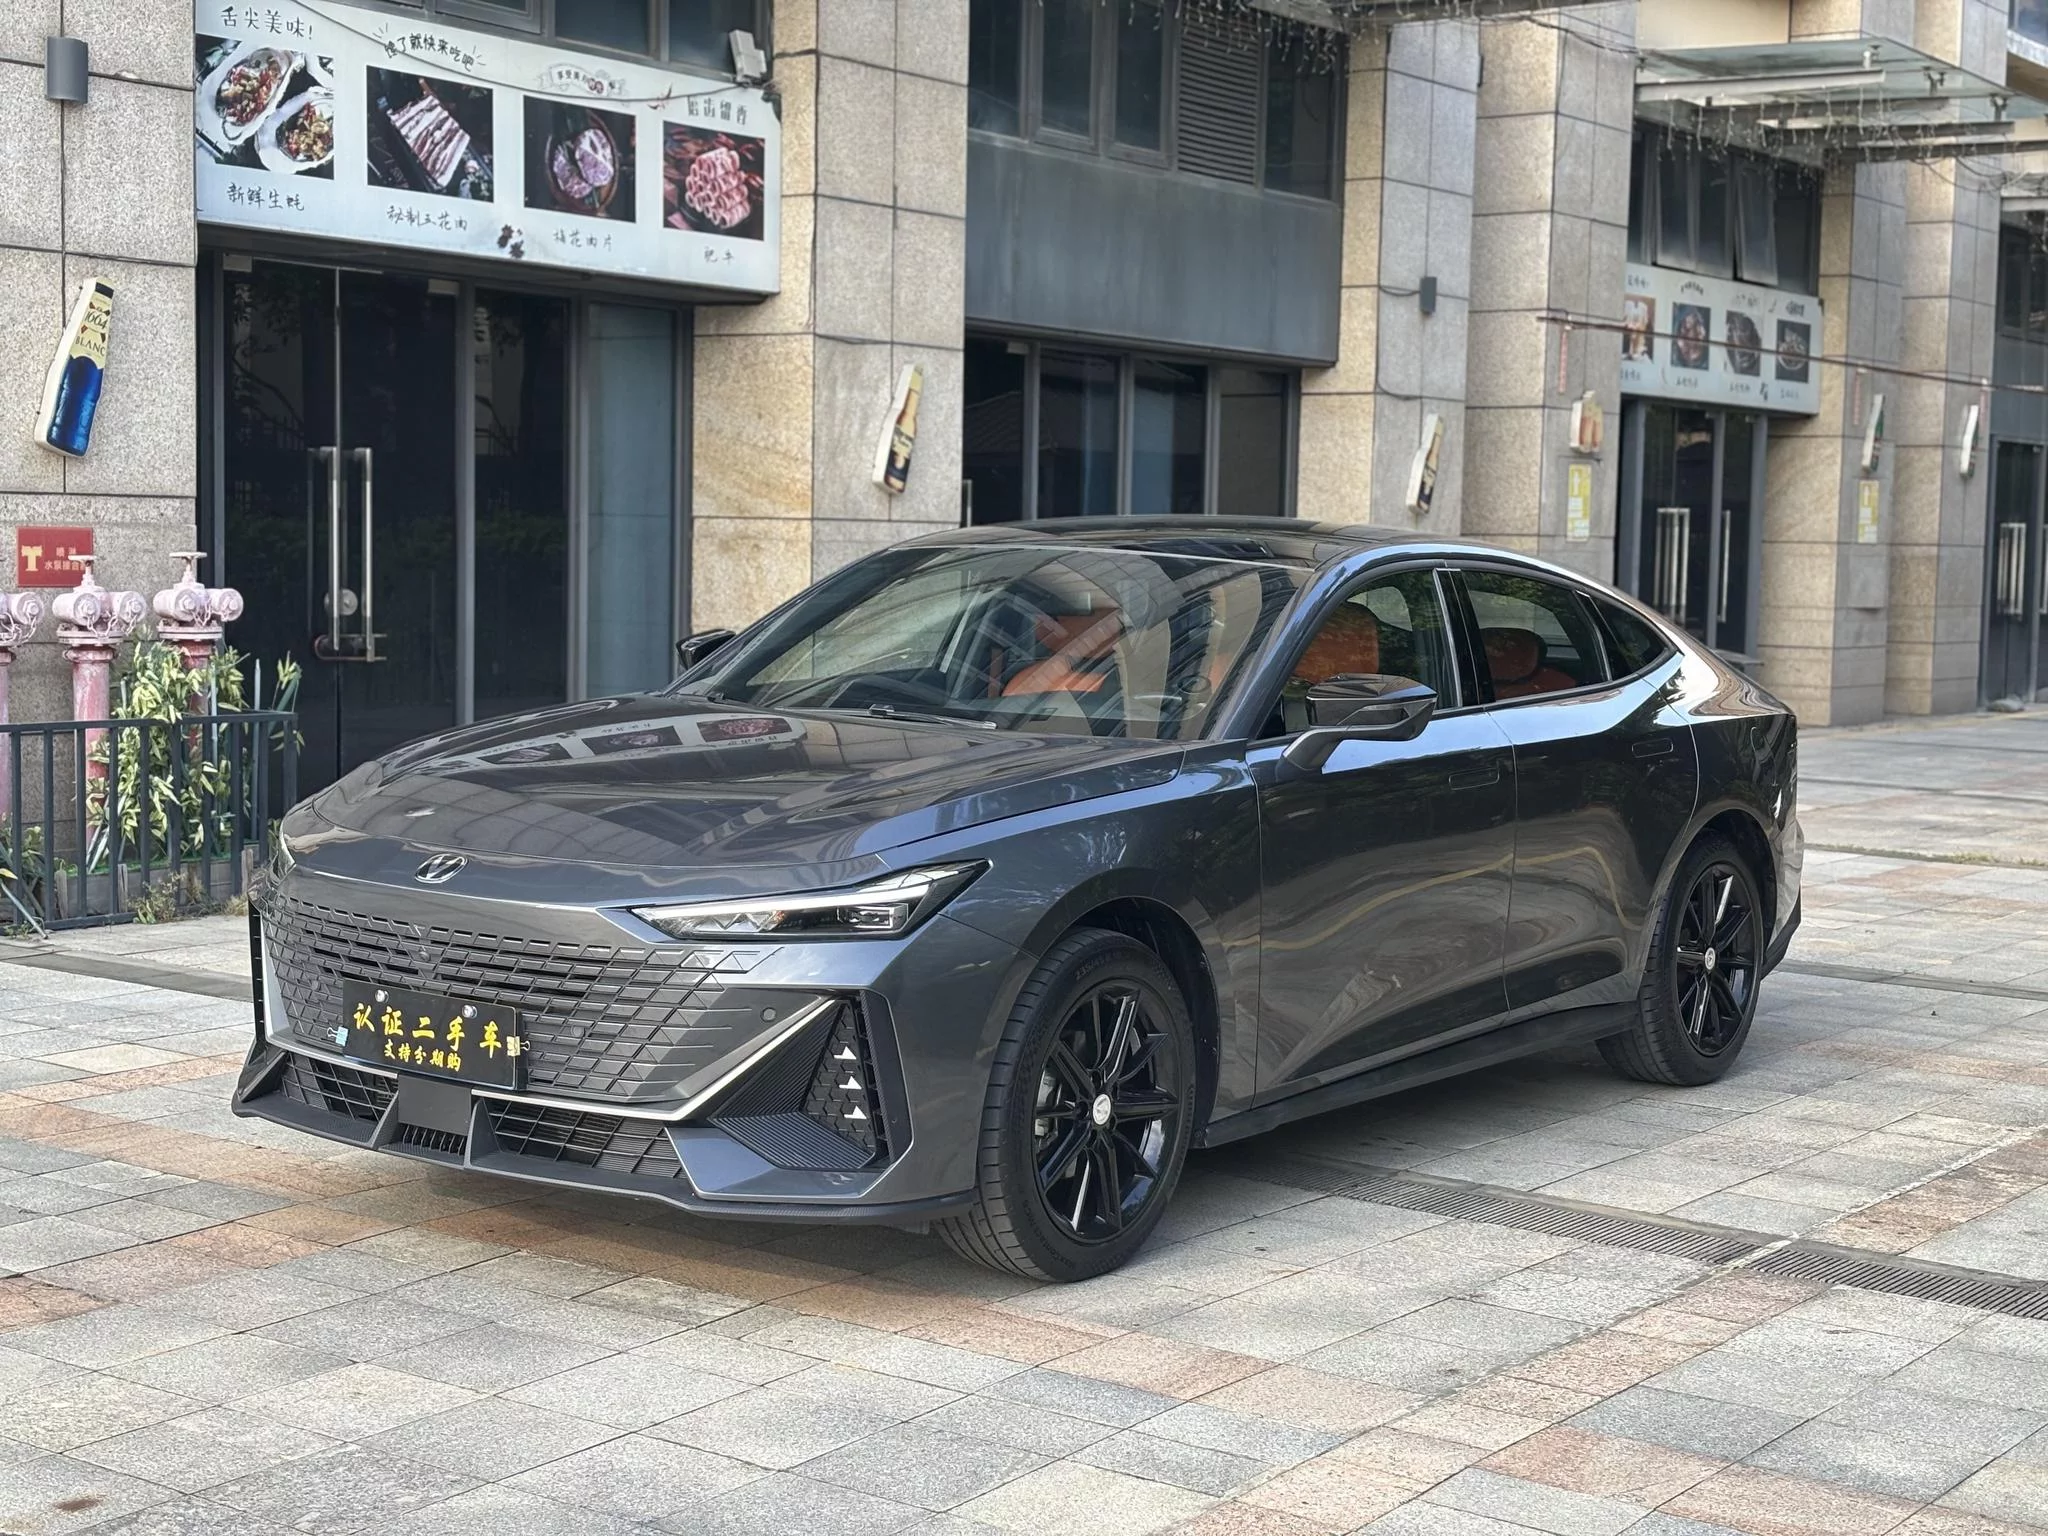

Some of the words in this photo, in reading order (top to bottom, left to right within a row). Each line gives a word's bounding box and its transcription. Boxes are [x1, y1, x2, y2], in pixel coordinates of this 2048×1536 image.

[227, 182, 305, 211] 新鲜生蚝
[75, 335, 106, 357] BLANC
[353, 1002, 502, 1059] 认证二手车
[383, 1038, 462, 1072] 支持分期购
